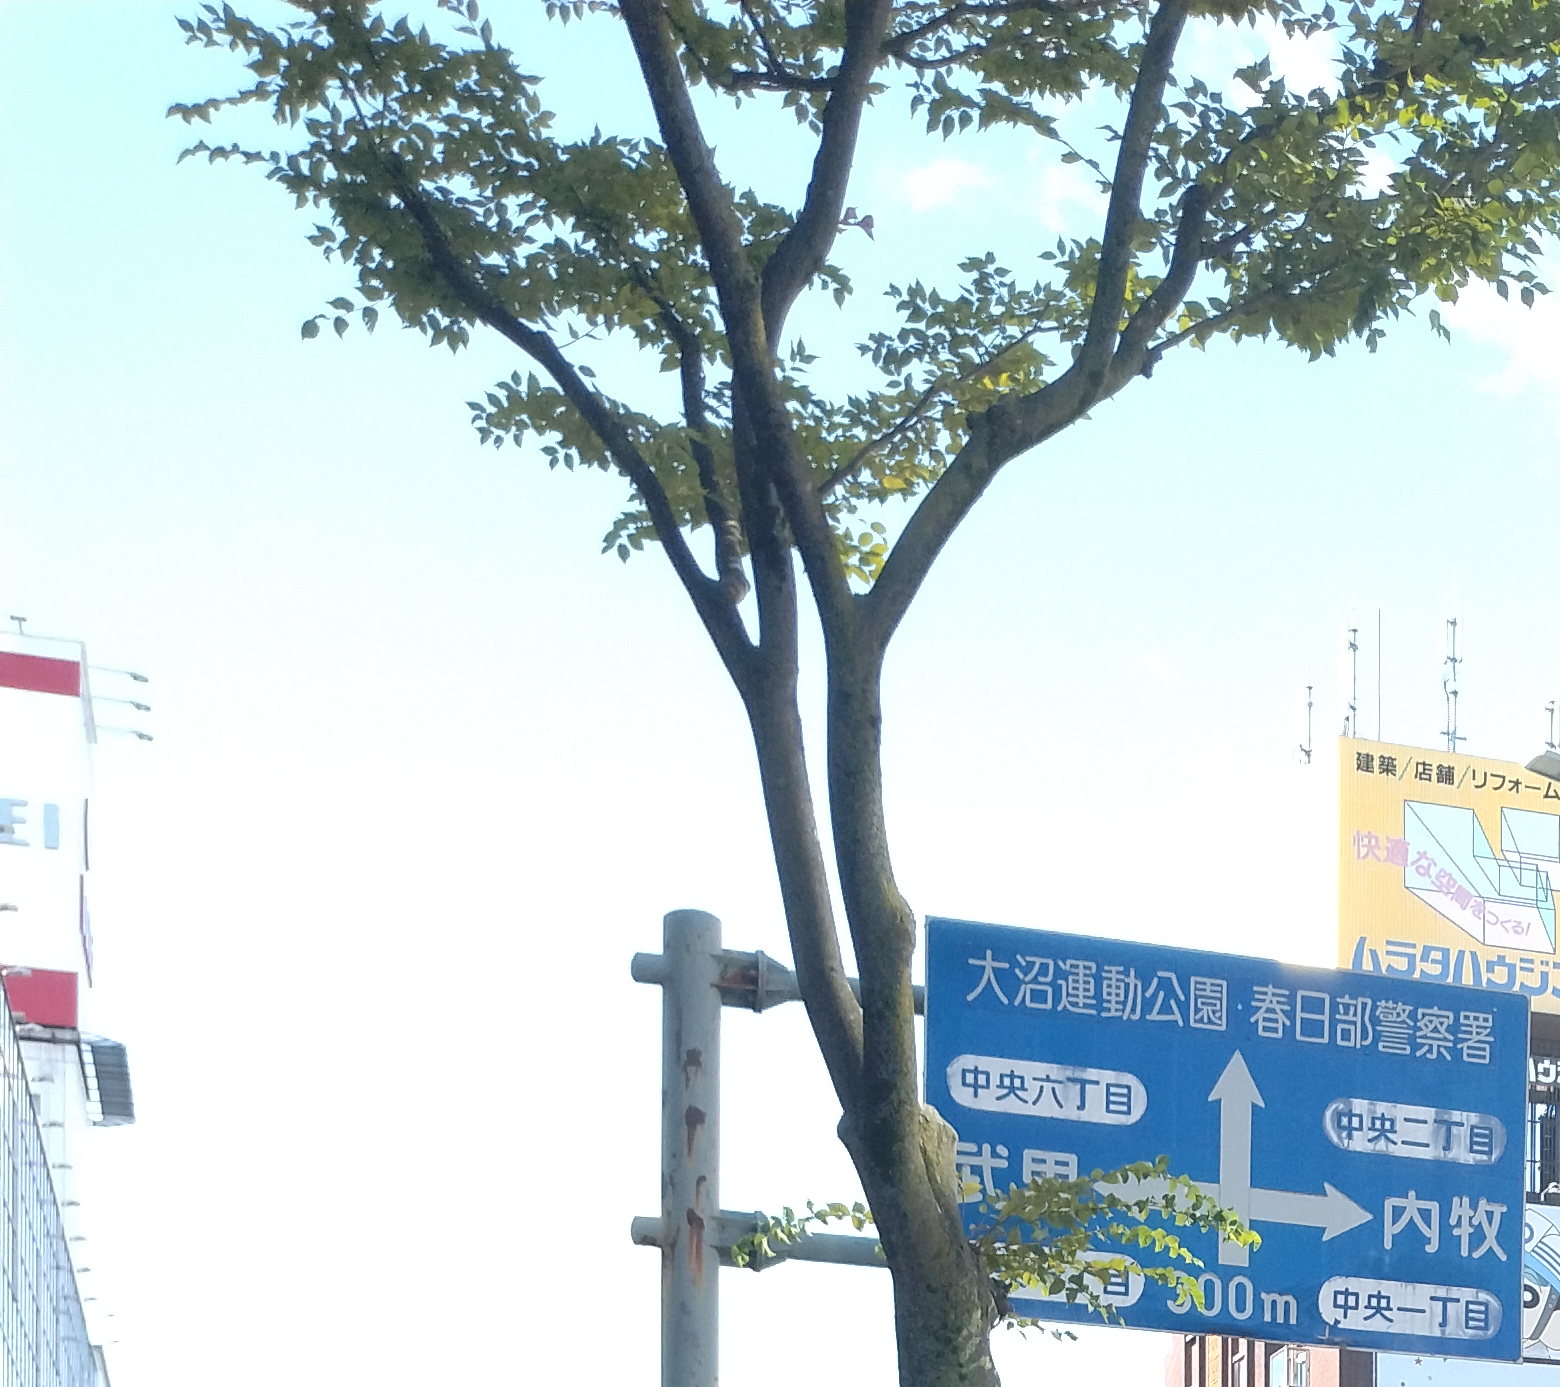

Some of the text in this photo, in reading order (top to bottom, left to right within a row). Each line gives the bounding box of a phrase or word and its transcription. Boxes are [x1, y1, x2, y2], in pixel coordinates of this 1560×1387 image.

[960, 1065, 1134, 1115] 中央六丁目
[1335, 1109, 1496, 1157] 中央二丁目
[1383, 1190, 1508, 1262] 内牧
[1332, 1289, 1491, 1331] 中央一丁目
